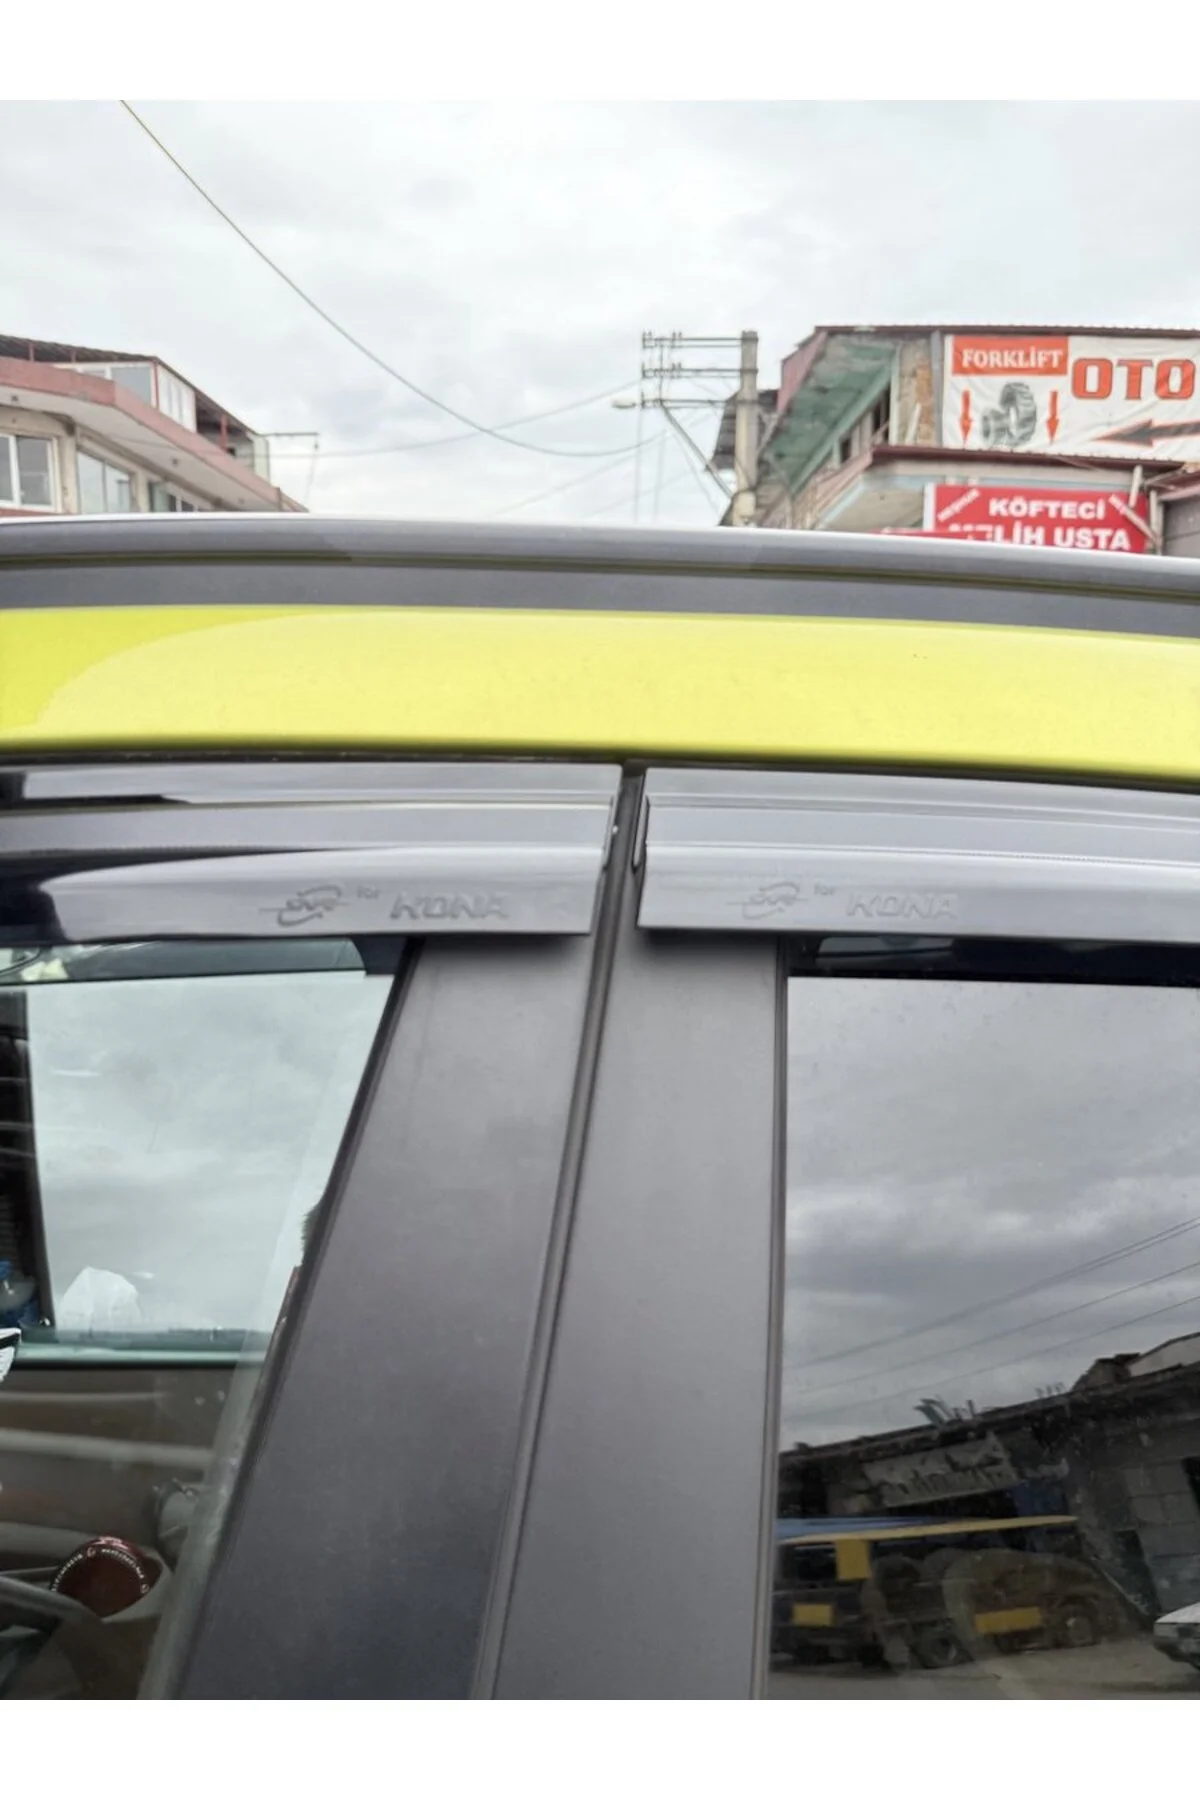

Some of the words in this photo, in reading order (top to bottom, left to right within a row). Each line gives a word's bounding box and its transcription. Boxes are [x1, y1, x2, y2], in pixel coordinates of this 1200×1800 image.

[961, 346, 1063, 369] FORKLİFT
[1071, 357, 1196, 400] OTO
[989, 497, 1105, 520] KÖFTECİ
[948, 520, 1045, 546] LİH
[1053, 527, 1131, 550] USTA
[845, 892, 959, 919] KONA
